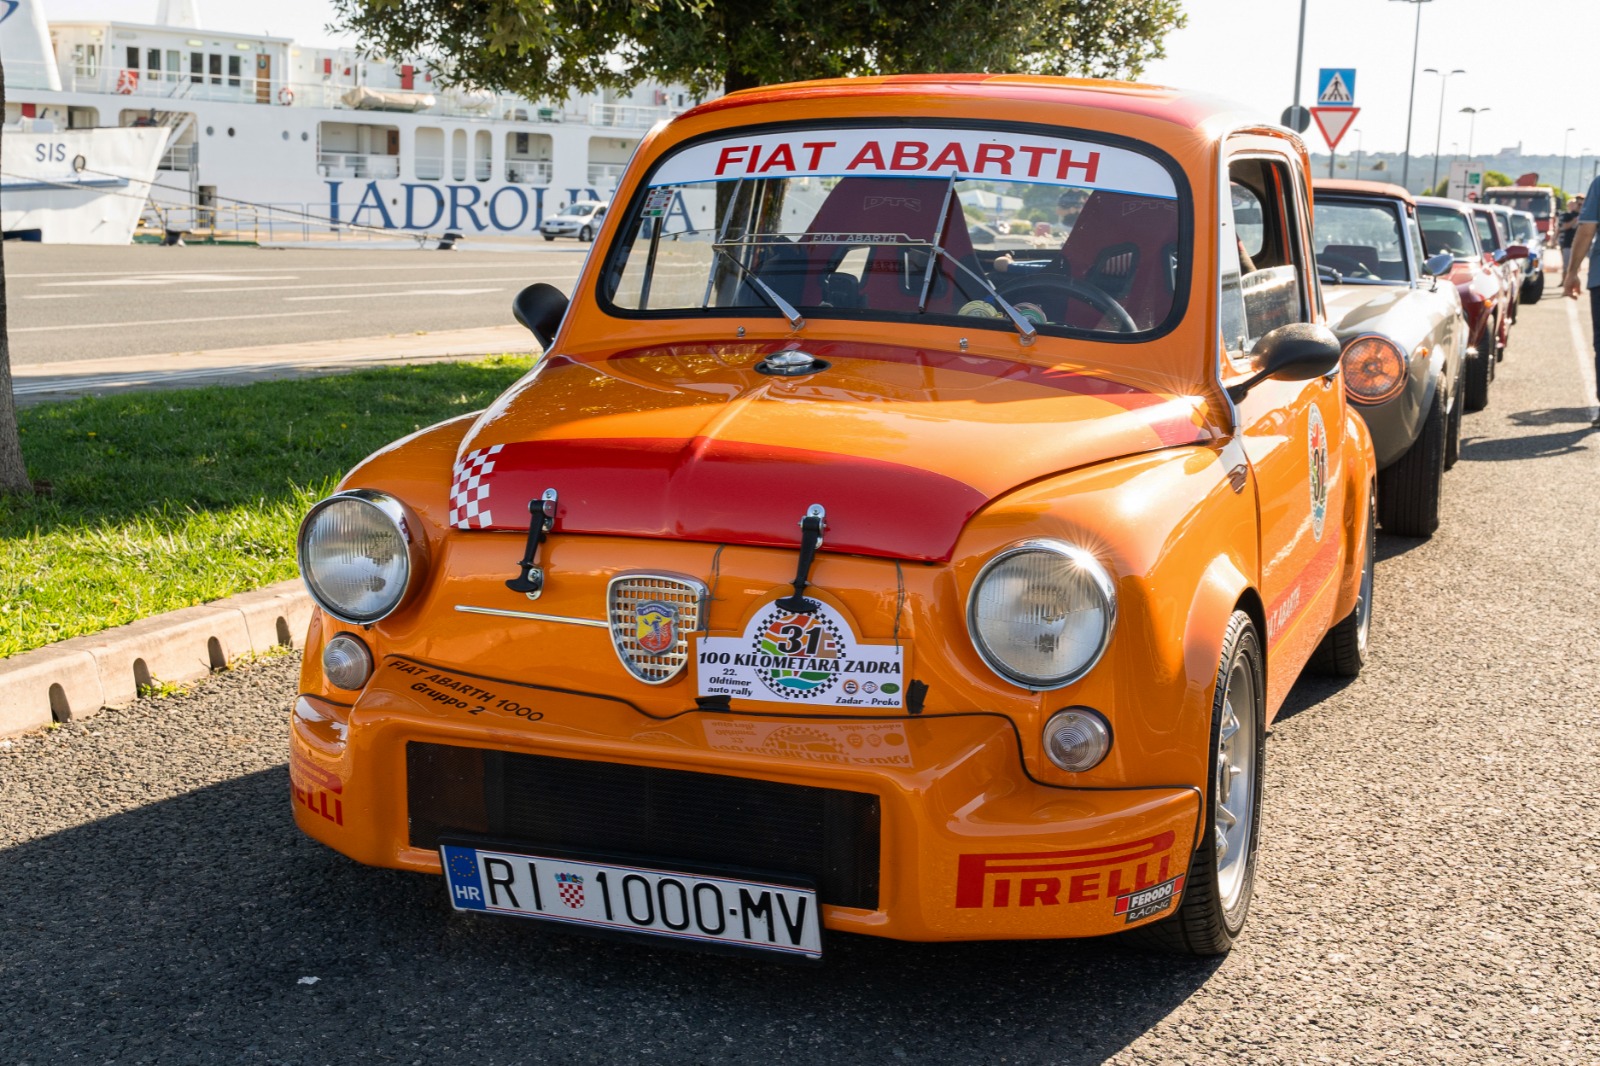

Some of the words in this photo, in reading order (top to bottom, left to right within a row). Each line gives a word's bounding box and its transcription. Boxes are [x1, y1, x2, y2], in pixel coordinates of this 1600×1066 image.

[36, 143, 66, 162] SIS
[714, 141, 836, 176] FIAT
[845, 141, 1101, 183] ABARTH
[812, 234, 841, 243] FIAT
[846, 234, 898, 243] ABARTH
[777, 625, 822, 655] 31
[699, 652, 731, 665] 100
[733, 653, 840, 673] KILOMETARA
[844, 660, 901, 674] ZADRA
[722, 668, 738, 676] 22.
[388, 660, 428, 677] FIAT
[425, 671, 496, 703] ABARTH
[497, 699, 545, 722] 1000
[707, 686, 729, 694] auto
[731, 687, 754, 698] rally
[709, 676, 752, 687] Oldtimer
[410, 682, 468, 709] Gruppo
[469, 705, 486, 716] 2
[835, 696, 864, 705] Zadar
[871, 697, 900, 706] Preko
[955, 830, 1175, 909] PIRELLI
[455, 885, 481, 901] HR
[482, 856, 545, 911] RI
[1131, 883, 1172, 908] FERODO
[1129, 899, 1168, 921] RACING
